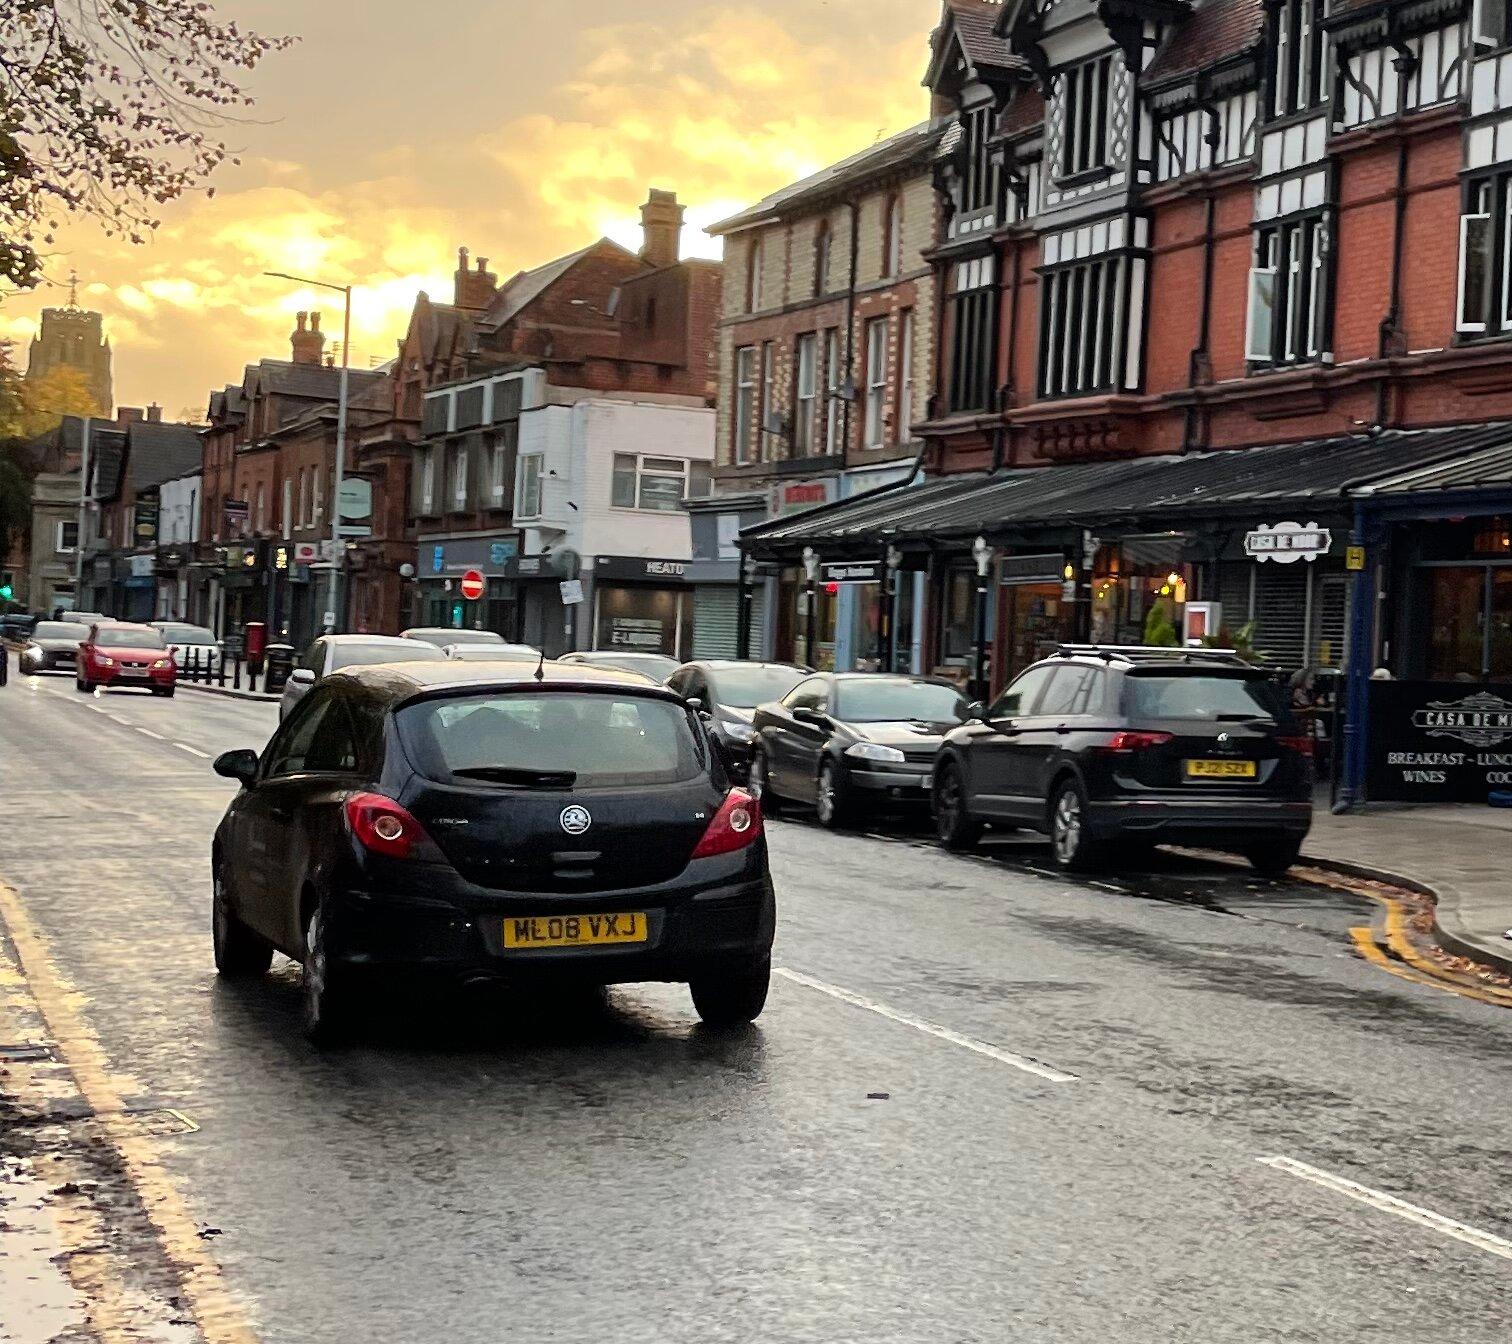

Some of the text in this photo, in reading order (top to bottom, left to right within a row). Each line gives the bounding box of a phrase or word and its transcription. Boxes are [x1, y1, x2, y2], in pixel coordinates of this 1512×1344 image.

[1426, 713, 1465, 727] CASA
[1473, 713, 1491, 727] DE
[1388, 752, 1466, 765] BREAKFAST
[1403, 770, 1446, 783] WINES
[514, 913, 637, 943] ML08 VXJ
